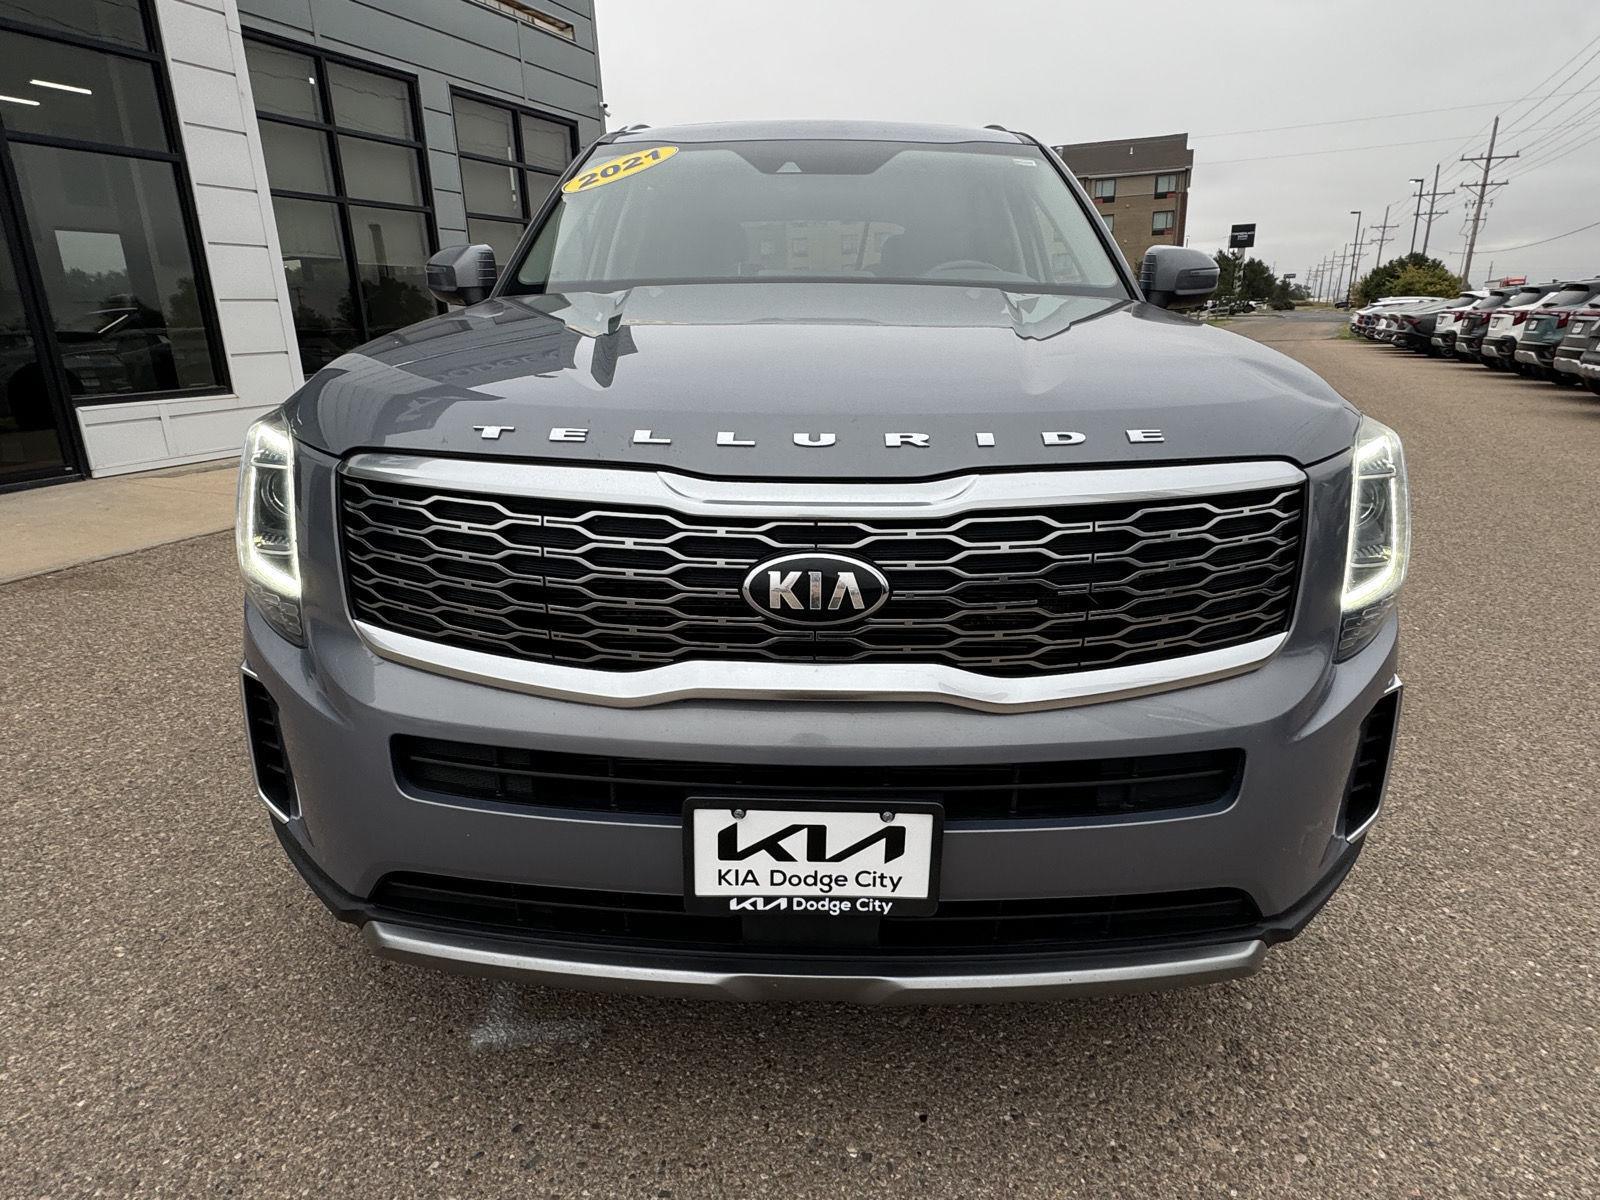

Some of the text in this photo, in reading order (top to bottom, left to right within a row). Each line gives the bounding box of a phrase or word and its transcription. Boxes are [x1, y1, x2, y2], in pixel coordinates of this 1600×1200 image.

[578, 149, 661, 189] 2021
[473, 425, 1165, 448] TELLURIDE
[767, 570, 866, 611] KIA
[717, 821, 907, 864] KIA
[717, 868, 903, 893] KIA Dodge City
[792, 897, 851, 916] Dodge
[855, 898, 893, 914] City
